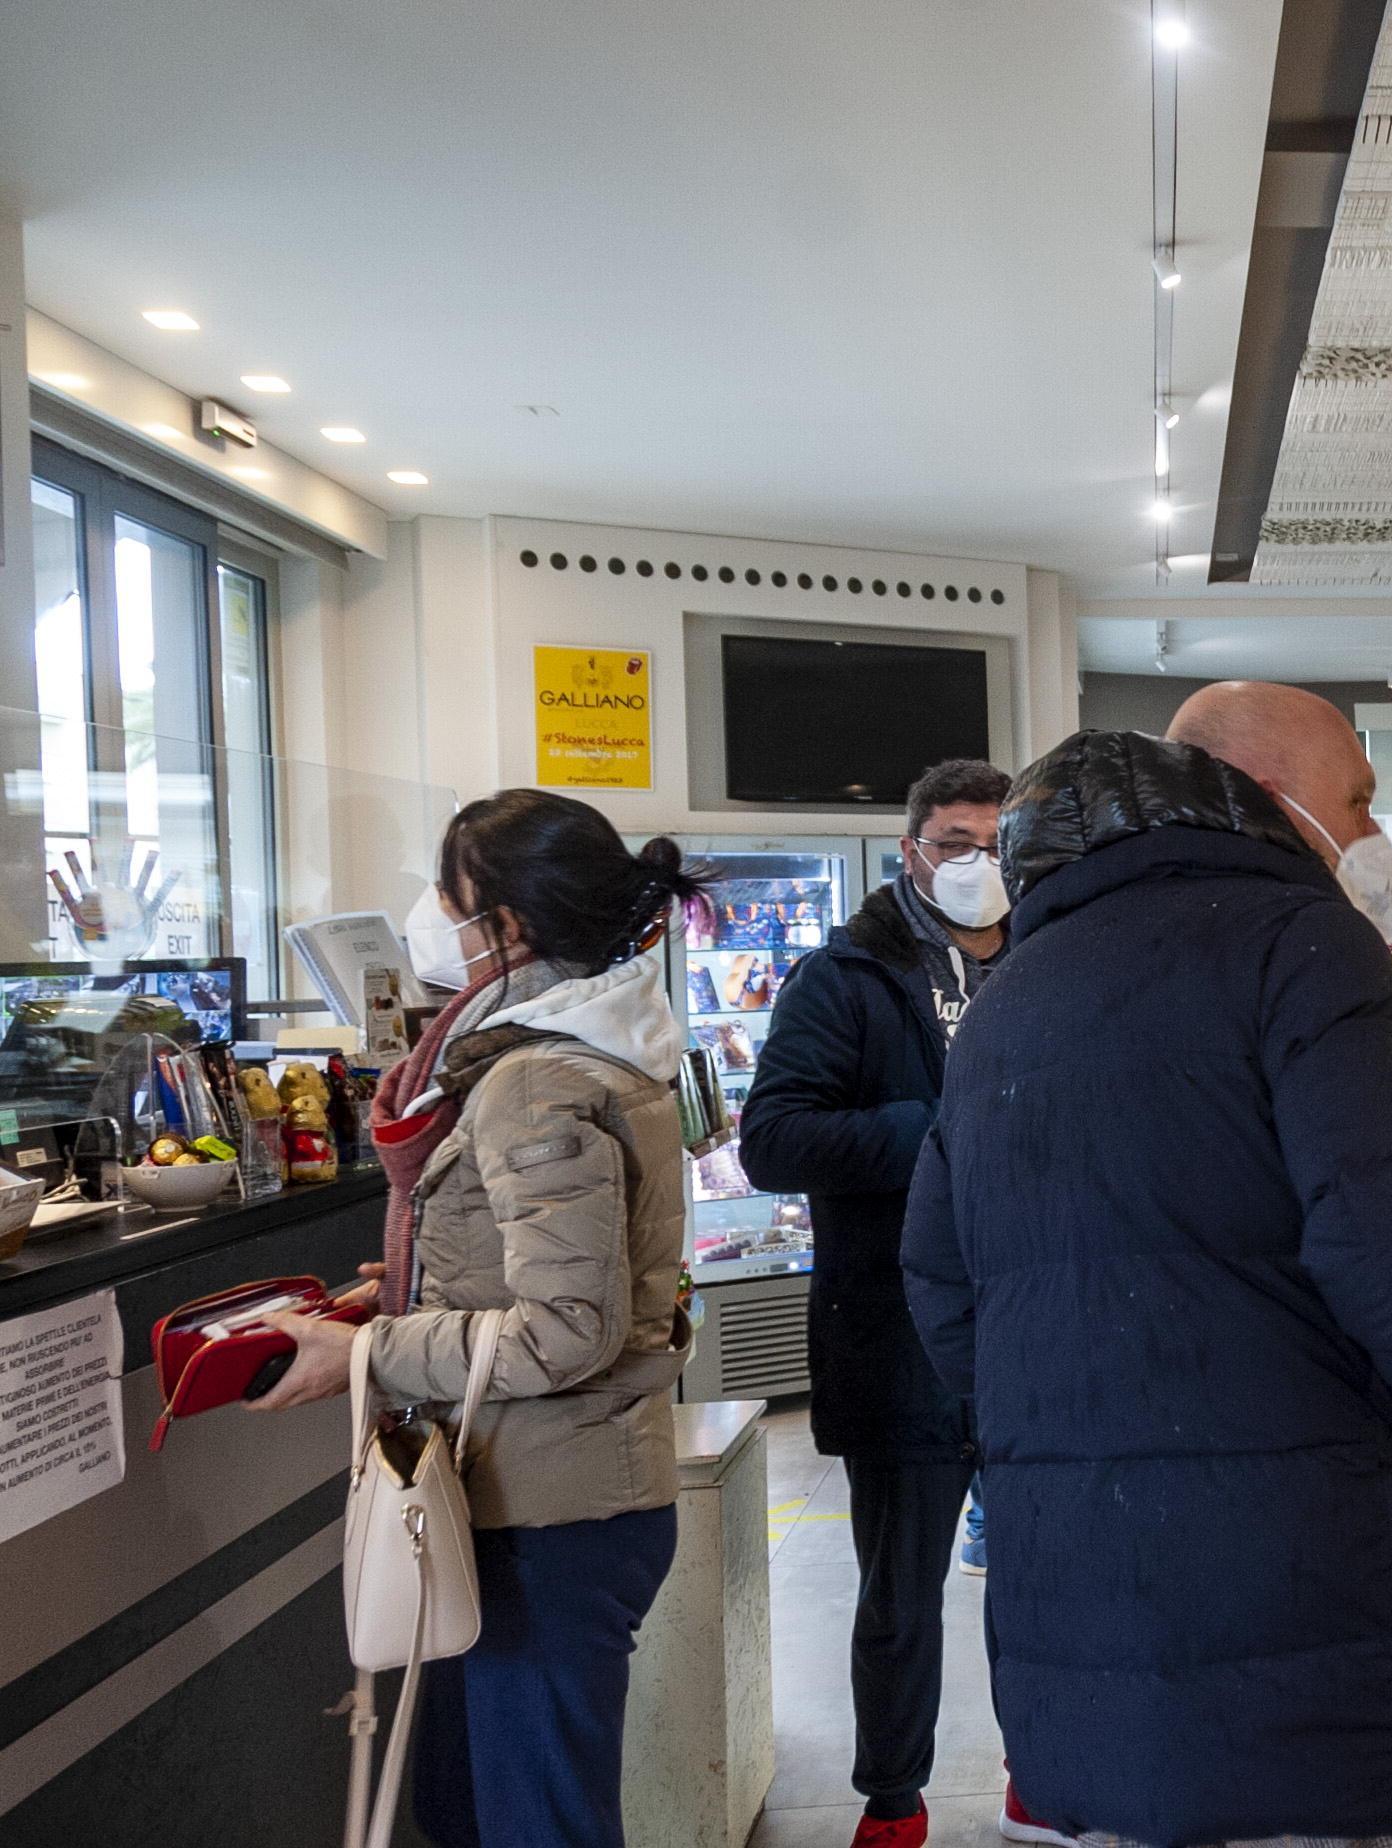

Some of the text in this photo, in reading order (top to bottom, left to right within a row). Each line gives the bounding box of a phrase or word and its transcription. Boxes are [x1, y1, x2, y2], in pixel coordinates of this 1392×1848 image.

[539, 690, 645, 710] GALLIANO
[543, 732, 646, 747] #StonesLucca
[168, 935, 192, 955] EXIT
[79, 1450, 111, 1473] GALLIANO
